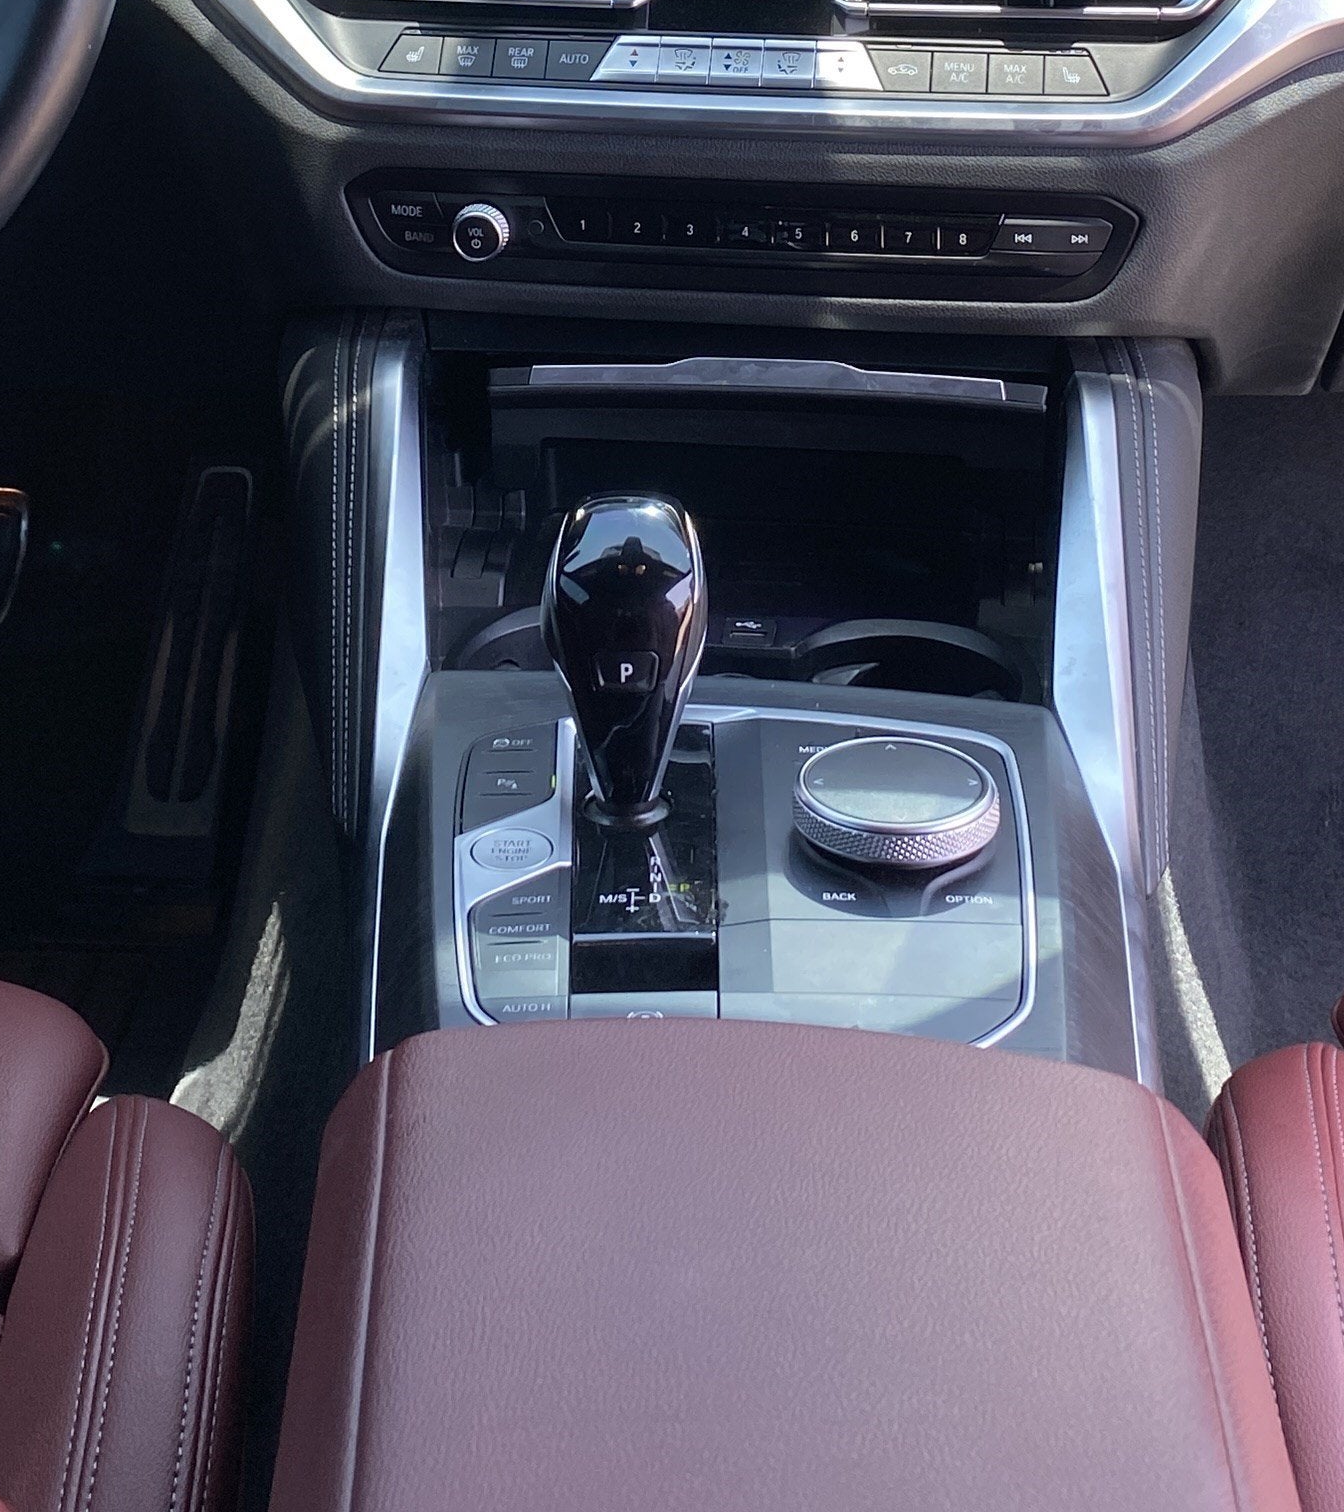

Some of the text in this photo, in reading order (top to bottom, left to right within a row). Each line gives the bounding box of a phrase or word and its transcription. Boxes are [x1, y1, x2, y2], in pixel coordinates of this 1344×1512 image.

[457, 45, 479, 56] MAX
[508, 47, 534, 57] REAR
[559, 53, 589, 65] AUTO
[733, 65, 749, 74] OFF
[944, 62, 974, 73] MENU
[1003, 64, 1027, 74] MAX
[950, 72, 969, 83] A/C
[1006, 74, 1025, 84] A/C
[391, 204, 423, 217] MODE
[580, 219, 585, 230] 1
[634, 222, 641, 234] 2
[687, 224, 693, 235] 3
[405, 231, 434, 243] BAND
[467, 227, 484, 237] VOL
[741, 226, 749, 237] 4
[795, 228, 802, 239] 5
[851, 230, 858, 241] 6
[905, 231, 912, 243] 7
[959, 233, 967, 245] 8
[620, 662, 633, 683] P
[512, 738, 533, 746] OFF
[799, 745, 827, 753] MED
[494, 839, 532, 847] START
[495, 854, 528, 862] STOP
[512, 895, 552, 904] SPORT
[599, 893, 661, 904] M/S D
[822, 892, 856, 901] BACK
[945, 894, 993, 905] OPTION
[489, 923, 550, 935] COMFORT
[495, 953, 552, 964] ECO PRO
[502, 1003, 551, 1013] AUTO H
